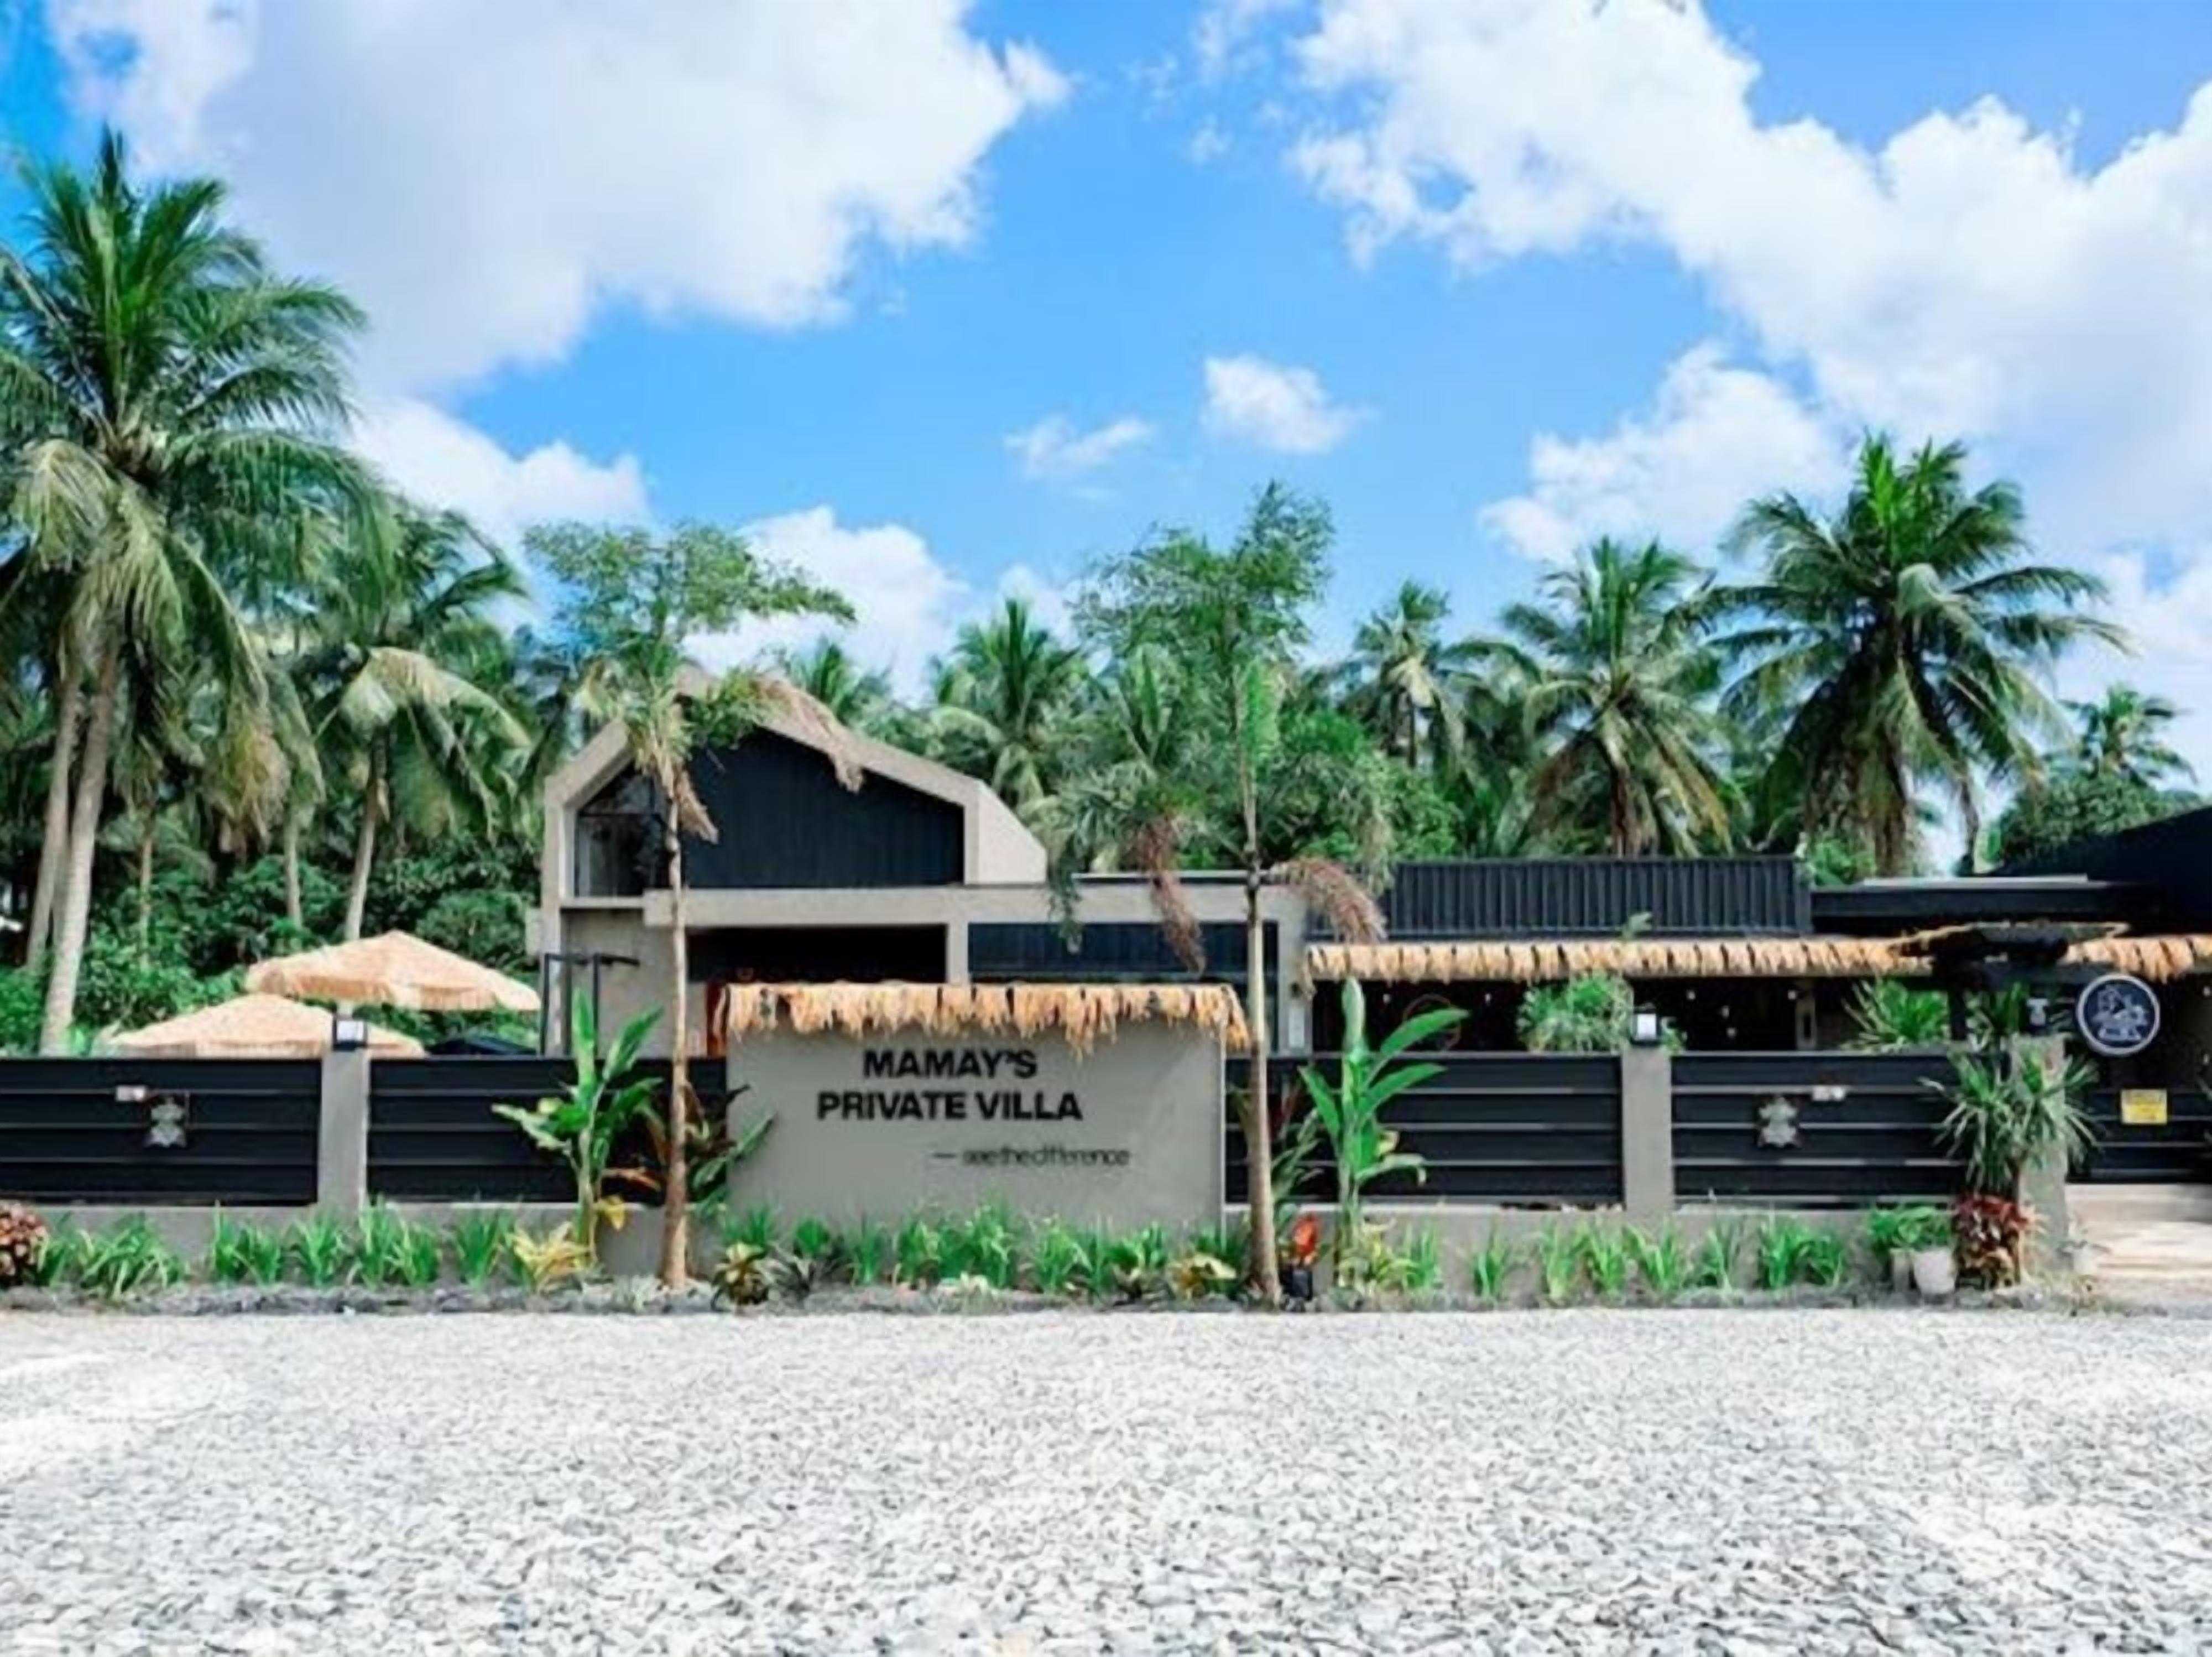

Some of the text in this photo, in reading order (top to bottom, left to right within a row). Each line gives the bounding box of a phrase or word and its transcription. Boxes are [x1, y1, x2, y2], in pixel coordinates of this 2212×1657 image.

[864, 1049, 1037, 1079] MAMAY'S
[817, 1090, 1083, 1121] PRIVATE VILLA
